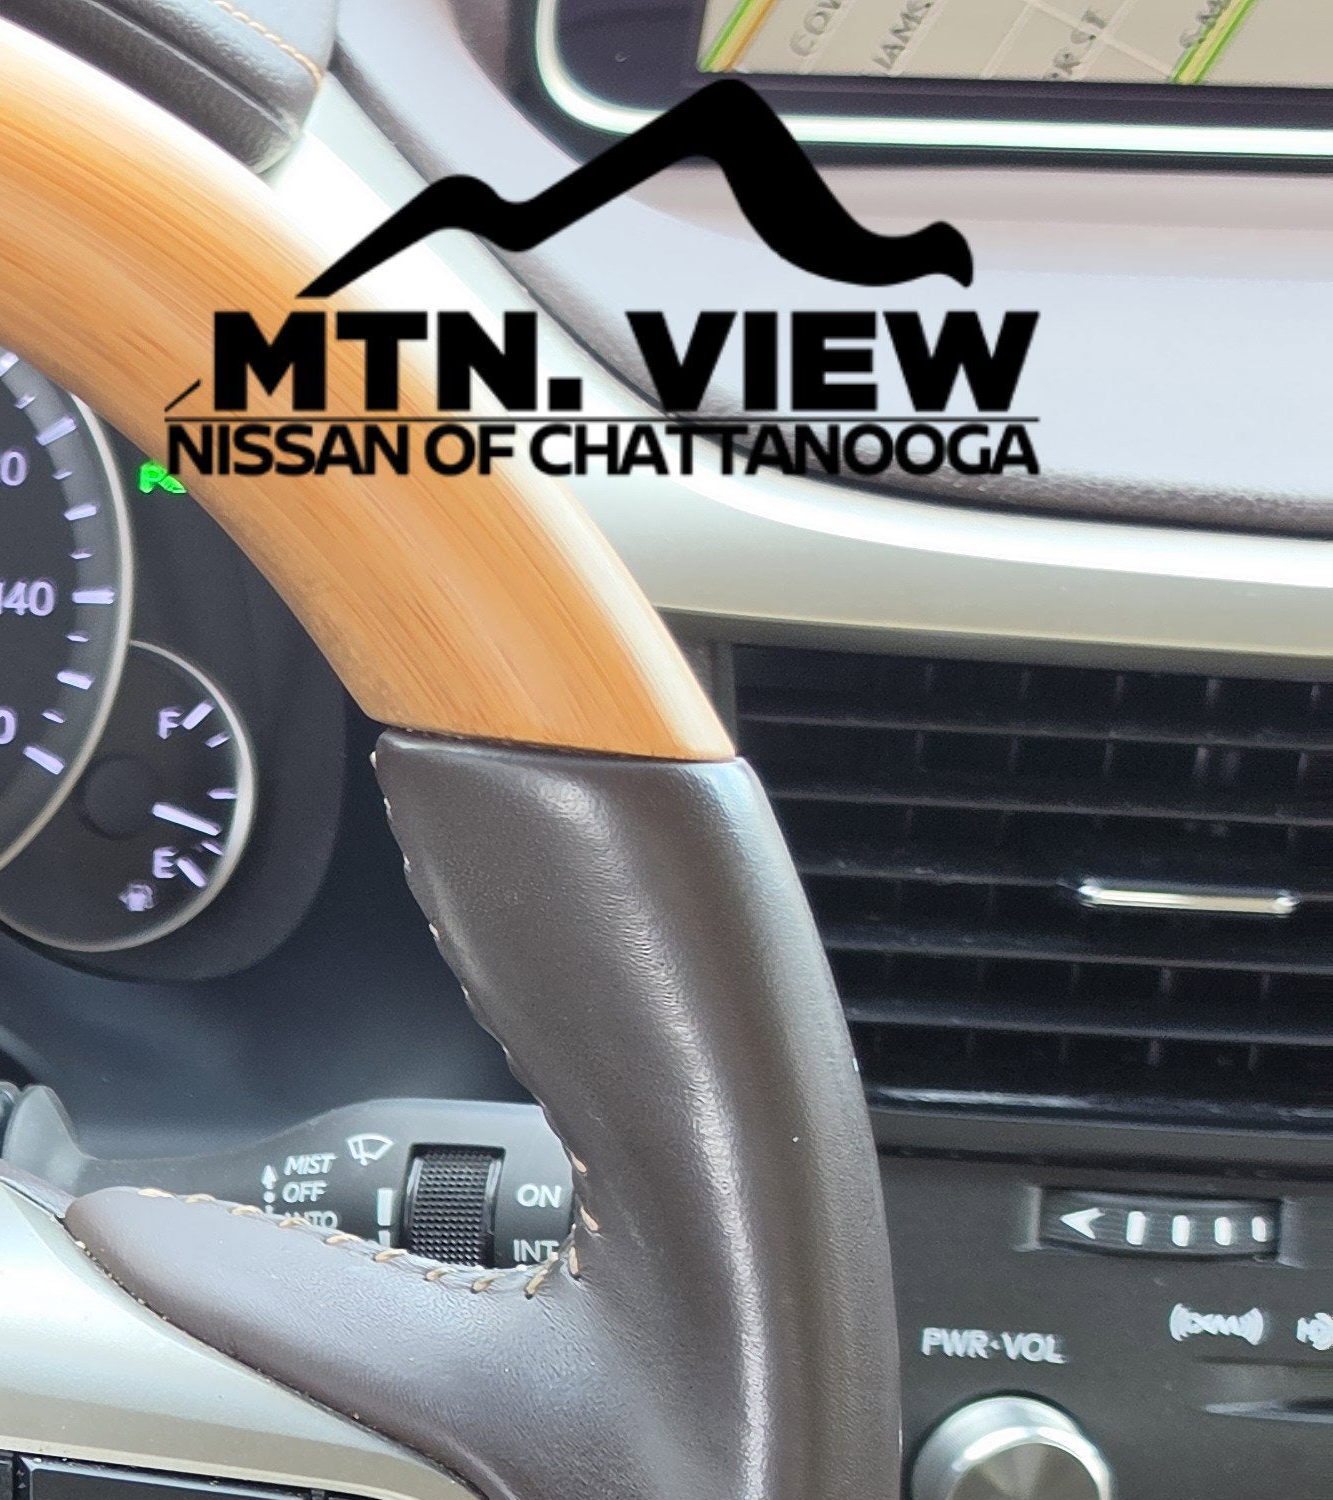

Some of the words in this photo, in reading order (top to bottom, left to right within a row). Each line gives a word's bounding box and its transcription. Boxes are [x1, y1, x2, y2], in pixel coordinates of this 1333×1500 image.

[158, 710, 181, 738] F
[152, 849, 176, 878] E
[283, 1152, 337, 1176] MIST
[281, 1180, 328, 1203] OFF
[517, 1183, 562, 1208] ON
[284, 1209, 339, 1230] TO
[513, 1239, 560, 1263] INT
